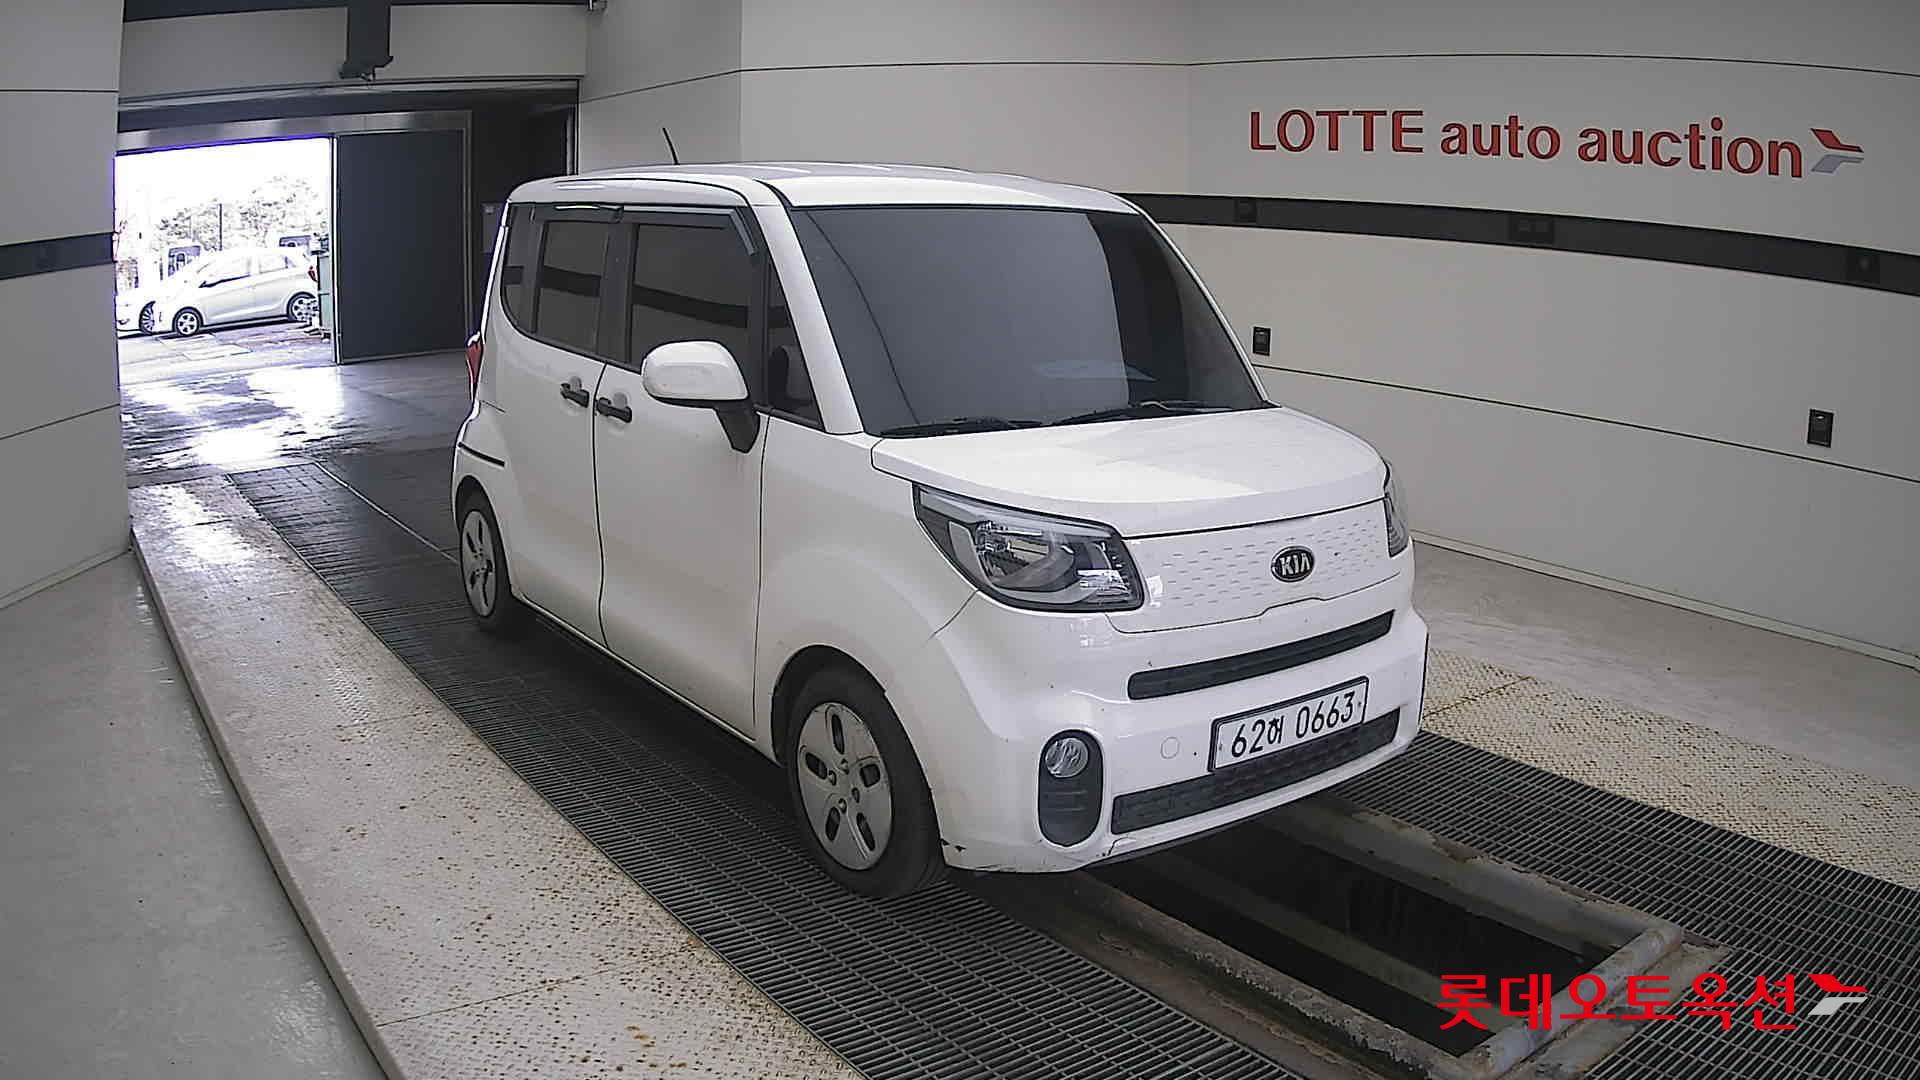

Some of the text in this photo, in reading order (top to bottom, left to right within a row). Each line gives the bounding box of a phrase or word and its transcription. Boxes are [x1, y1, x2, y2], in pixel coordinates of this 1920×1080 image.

[1250, 110, 1803, 178] LOTTE auto auction
[1279, 553, 1311, 576] KIA
[1231, 691, 1355, 757] 62허 0663
